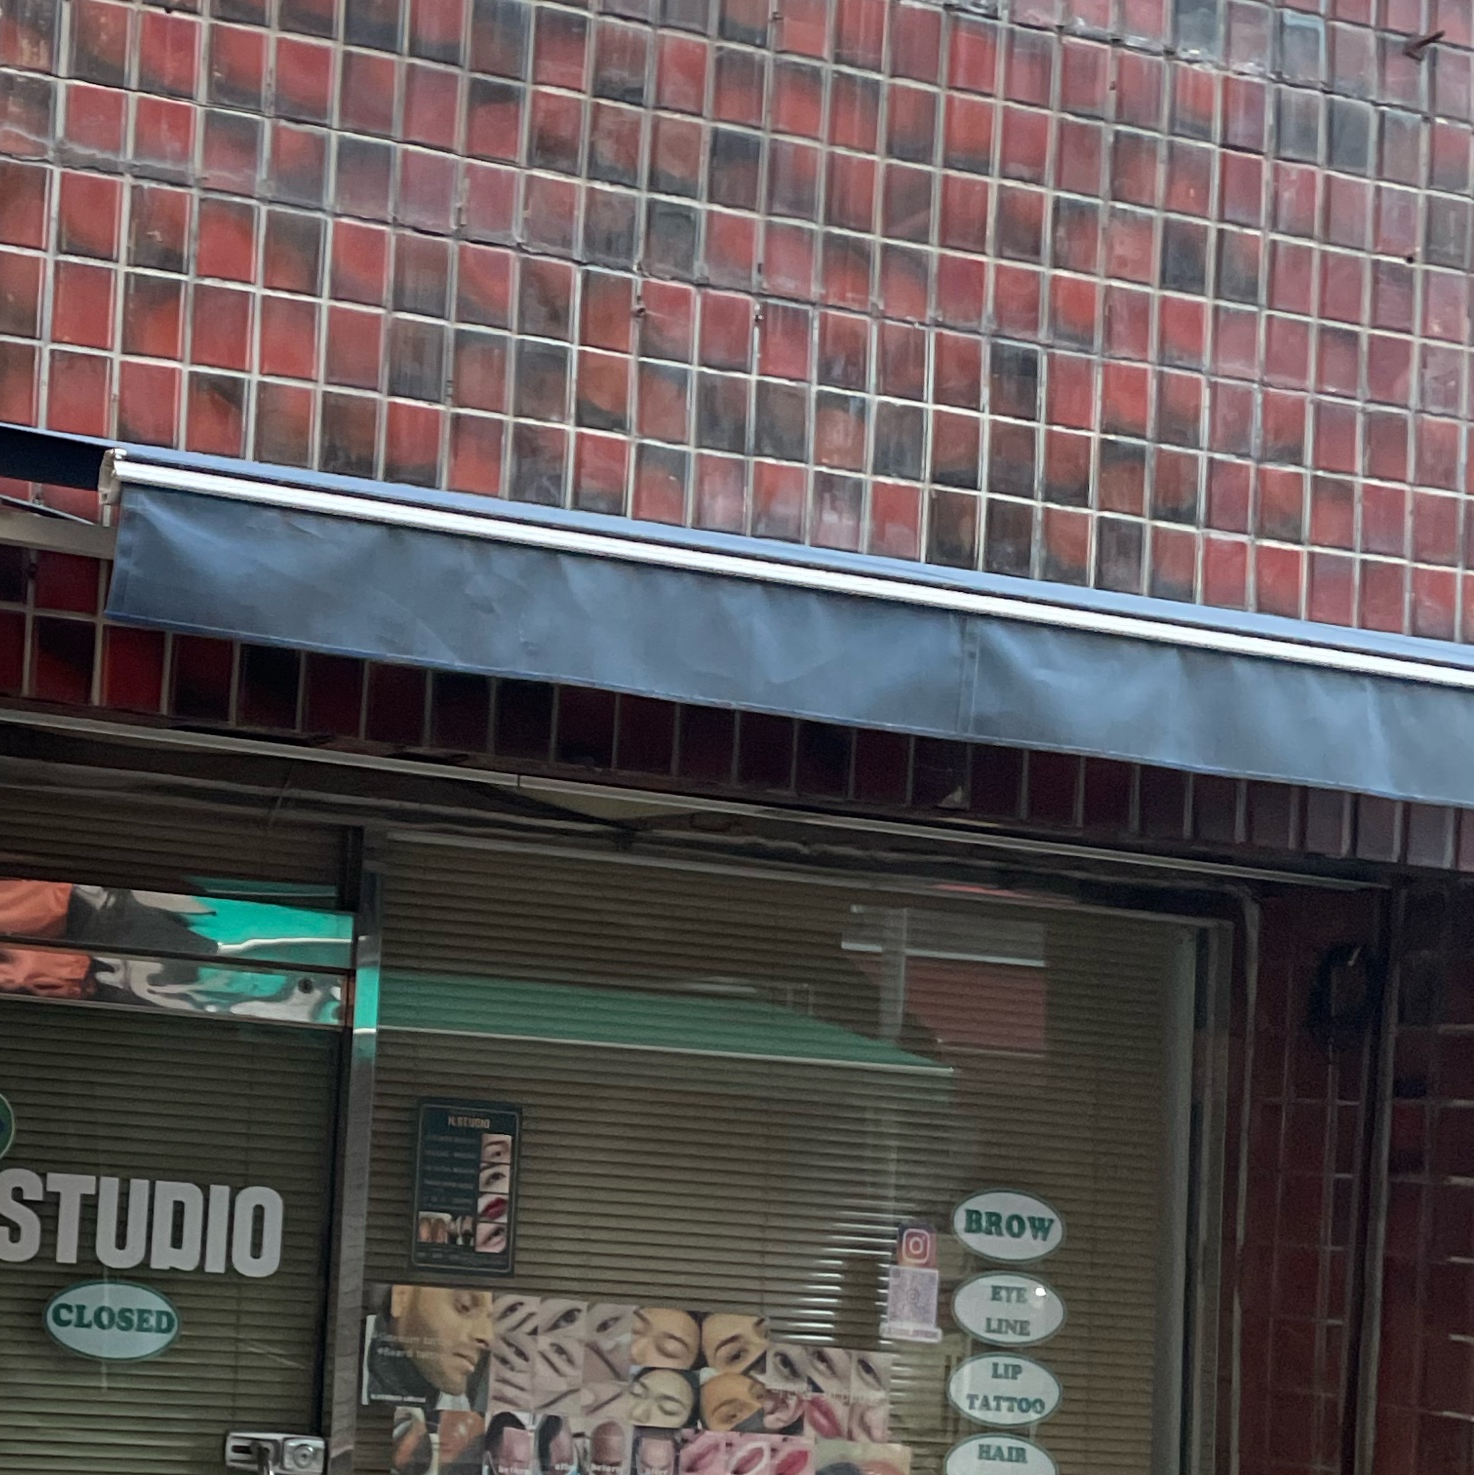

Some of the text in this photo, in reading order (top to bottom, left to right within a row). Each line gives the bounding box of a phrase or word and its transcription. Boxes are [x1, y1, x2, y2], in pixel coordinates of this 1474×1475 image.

[964, 1208, 1055, 1242] BROW
[991, 1285, 1027, 1302] EYE
[51, 1303, 176, 1335] CLOSED
[985, 1317, 1030, 1336] LINE
[992, 1362, 1023, 1380] LIP
[966, 1394, 1045, 1414] TATTOO
[978, 1444, 1027, 1464] HAIR
